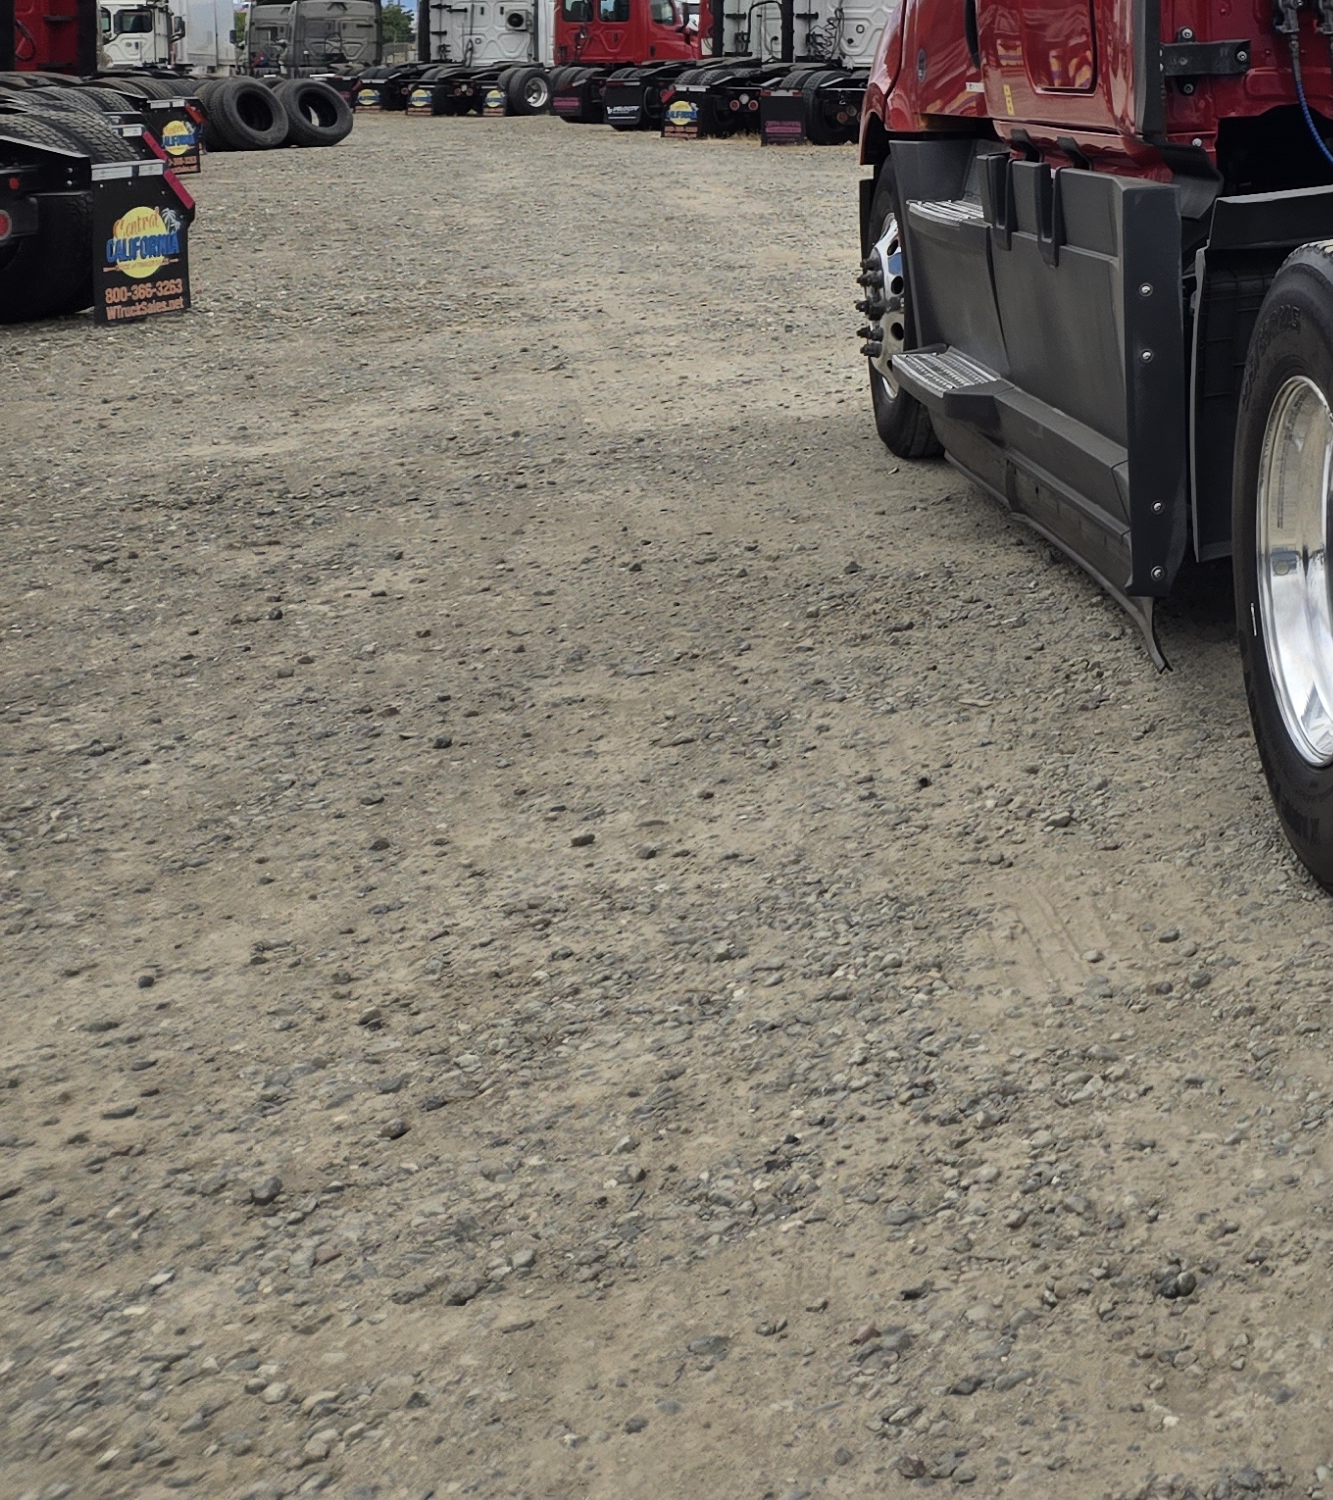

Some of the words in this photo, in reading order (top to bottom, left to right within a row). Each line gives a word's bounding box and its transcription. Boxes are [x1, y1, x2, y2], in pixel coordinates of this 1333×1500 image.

[113, 206, 160, 239] Central
[106, 230, 180, 263] CALIFORNIA
[105, 278, 183, 304] 800-366-3263
[106, 296, 184, 320] WTruckSales.net
